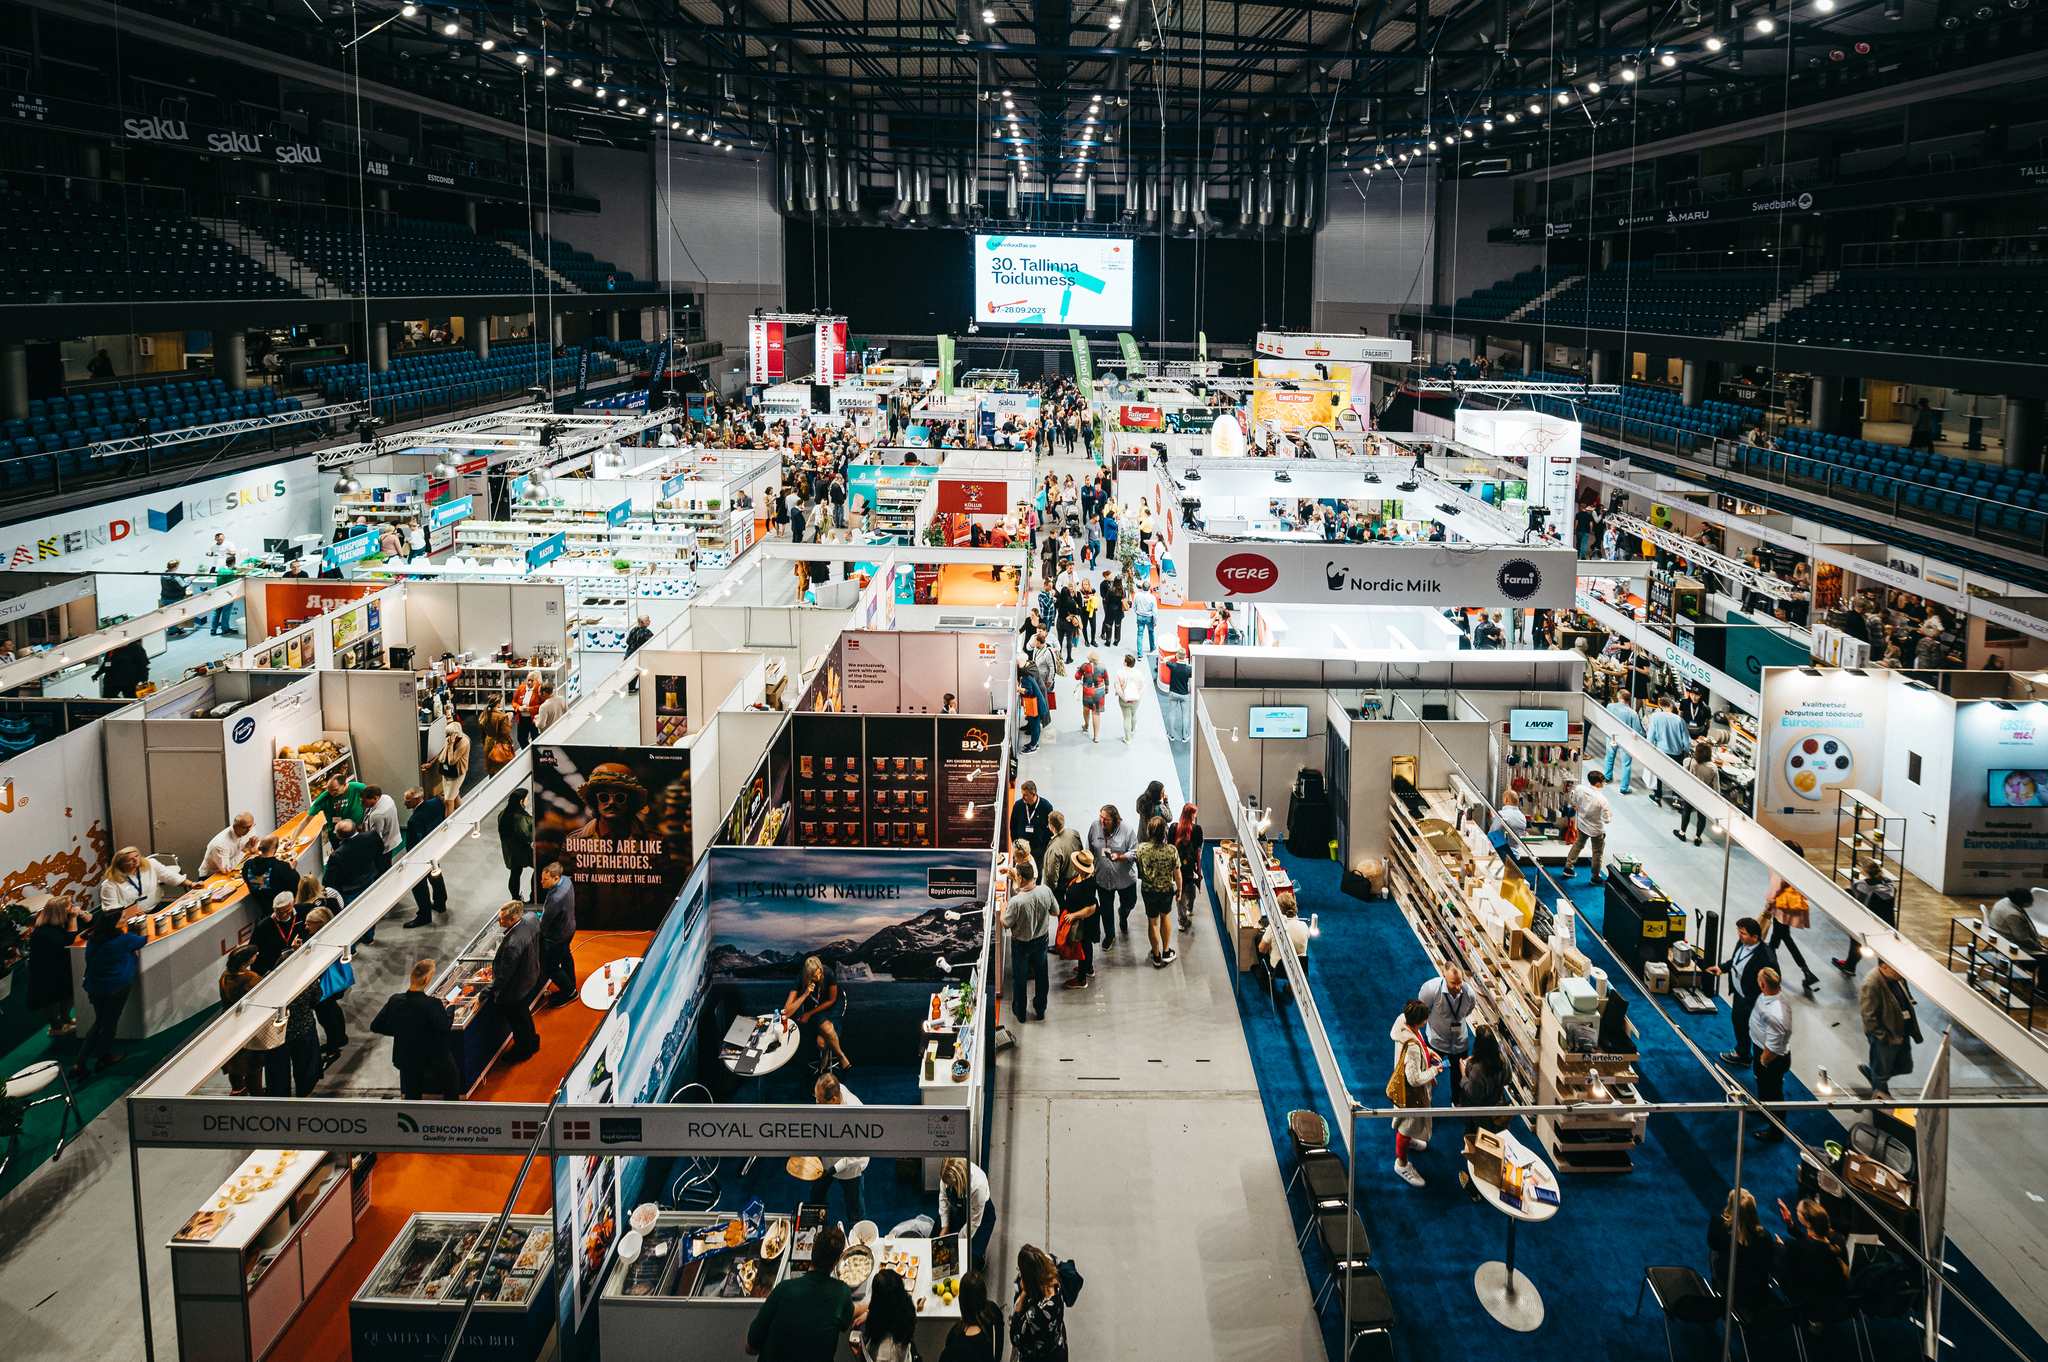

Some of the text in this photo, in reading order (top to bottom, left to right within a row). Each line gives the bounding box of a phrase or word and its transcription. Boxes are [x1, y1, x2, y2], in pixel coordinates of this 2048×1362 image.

[124, 116, 189, 140] saku
[208, 132, 261, 153] saku
[276, 144, 322, 164] saku
[367, 162, 389, 176] ABB
[1752, 198, 1797, 211] Swedbank
[1679, 211, 1709, 221] MARU
[1516, 228, 1530, 237] weber
[992, 258, 1080, 273] 30. Tallinna
[992, 272, 1076, 286] Toidumess
[992, 306, 1046, 314] 27.-28.09.2023
[755, 325, 763, 382] KitchenAid
[579, 354, 587, 390] euronics
[654, 352, 667, 382] euronics
[1294, 395, 1312, 403] Pagar
[190, 480, 286, 521] KESKUS
[1223, 567, 1270, 580] TERE
[1504, 571, 1535, 586] Farmi
[1853, 562, 1907, 586] IBERIC TAPAS OÜ
[1351, 577, 1442, 593] Nordic Milk
[1989, 609, 2012, 622] LAPIN
[1666, 647, 1712, 684] GEMOSS
[1802, 701, 1847, 709] Kvaliteetsed
[1785, 710, 1863, 719] hõrgutised töödeldud
[1782, 716, 1865, 730] Euroopalikult!
[1999, 718, 2034, 731] taste
[235, 721, 254, 741] Fazer
[2013, 728, 2036, 740] me!
[962, 741, 981, 749] BPI
[1985, 822, 2033, 830] Kvaliteetsed
[566, 838, 662, 855] BURGERS ARE LIKE
[576, 855, 653, 870] SUPERHEROES.
[574, 873, 662, 884] THEY ALWAYS SAVE THE DAY!
[737, 881, 901, 900] IT'S IN OUR NATURE!
[930, 888, 976, 897] Royal Greenland
[204, 1115, 368, 1135] DENCON FOODS
[422, 1125, 502, 1135] DENCON FOODS
[688, 1122, 885, 1140] ROYAL GREENLAND
[423, 1135, 447, 1143] Quality
[364, 1331, 519, 1347] QUALITY IN BITE
